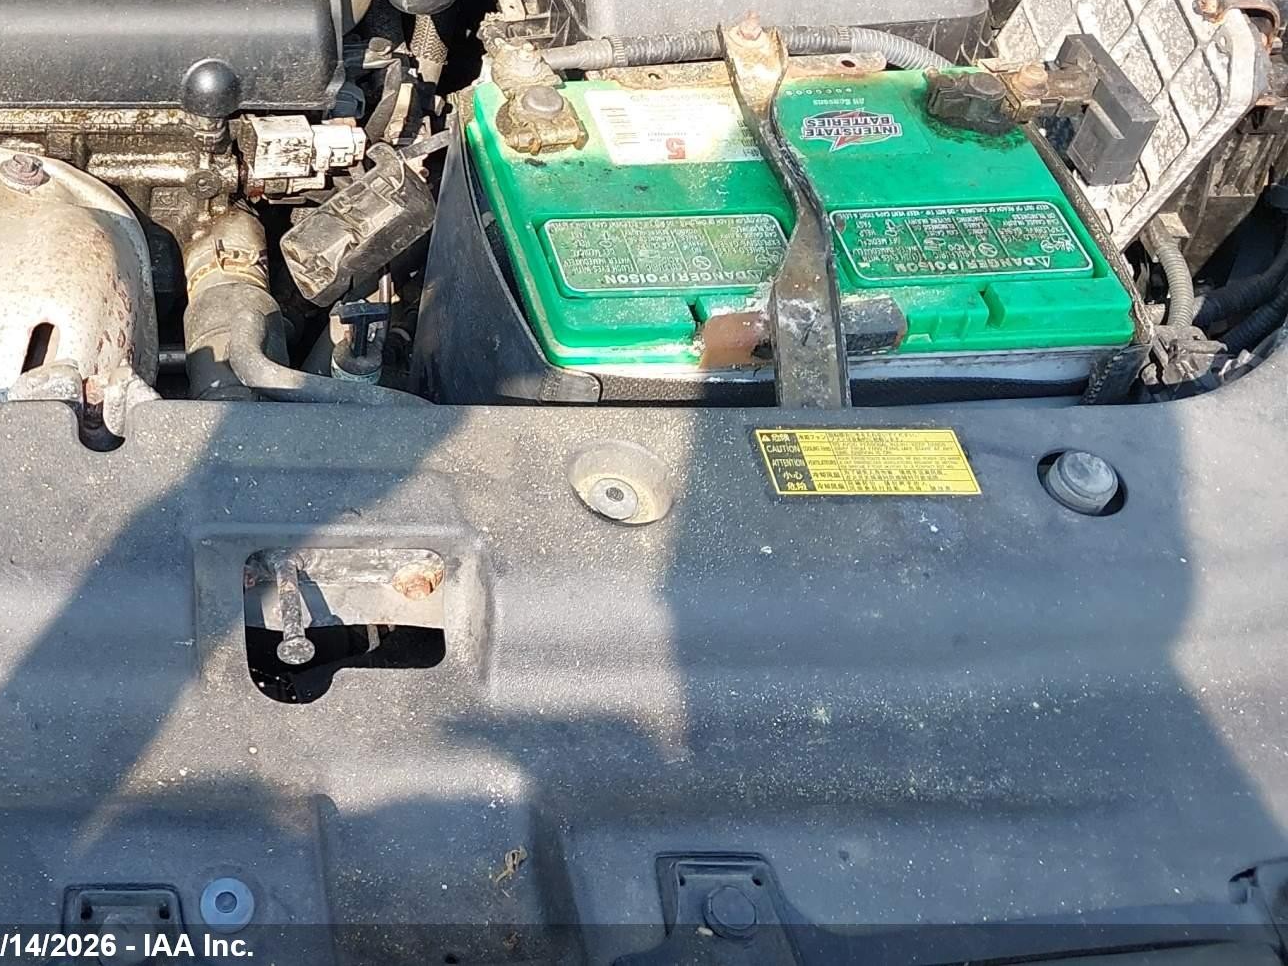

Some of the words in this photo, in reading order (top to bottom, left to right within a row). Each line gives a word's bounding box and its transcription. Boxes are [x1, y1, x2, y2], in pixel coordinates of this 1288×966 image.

[806, 116, 890, 127] BATTERIES
[805, 126, 898, 137] INTERSTATE
[666, 138, 687, 160] 5
[893, 256, 1036, 272] DANGER/POISON
[603, 269, 746, 284] DANGER/POISON
[767, 444, 801, 453] CAUTION
[772, 458, 806, 467] ATTENTION
